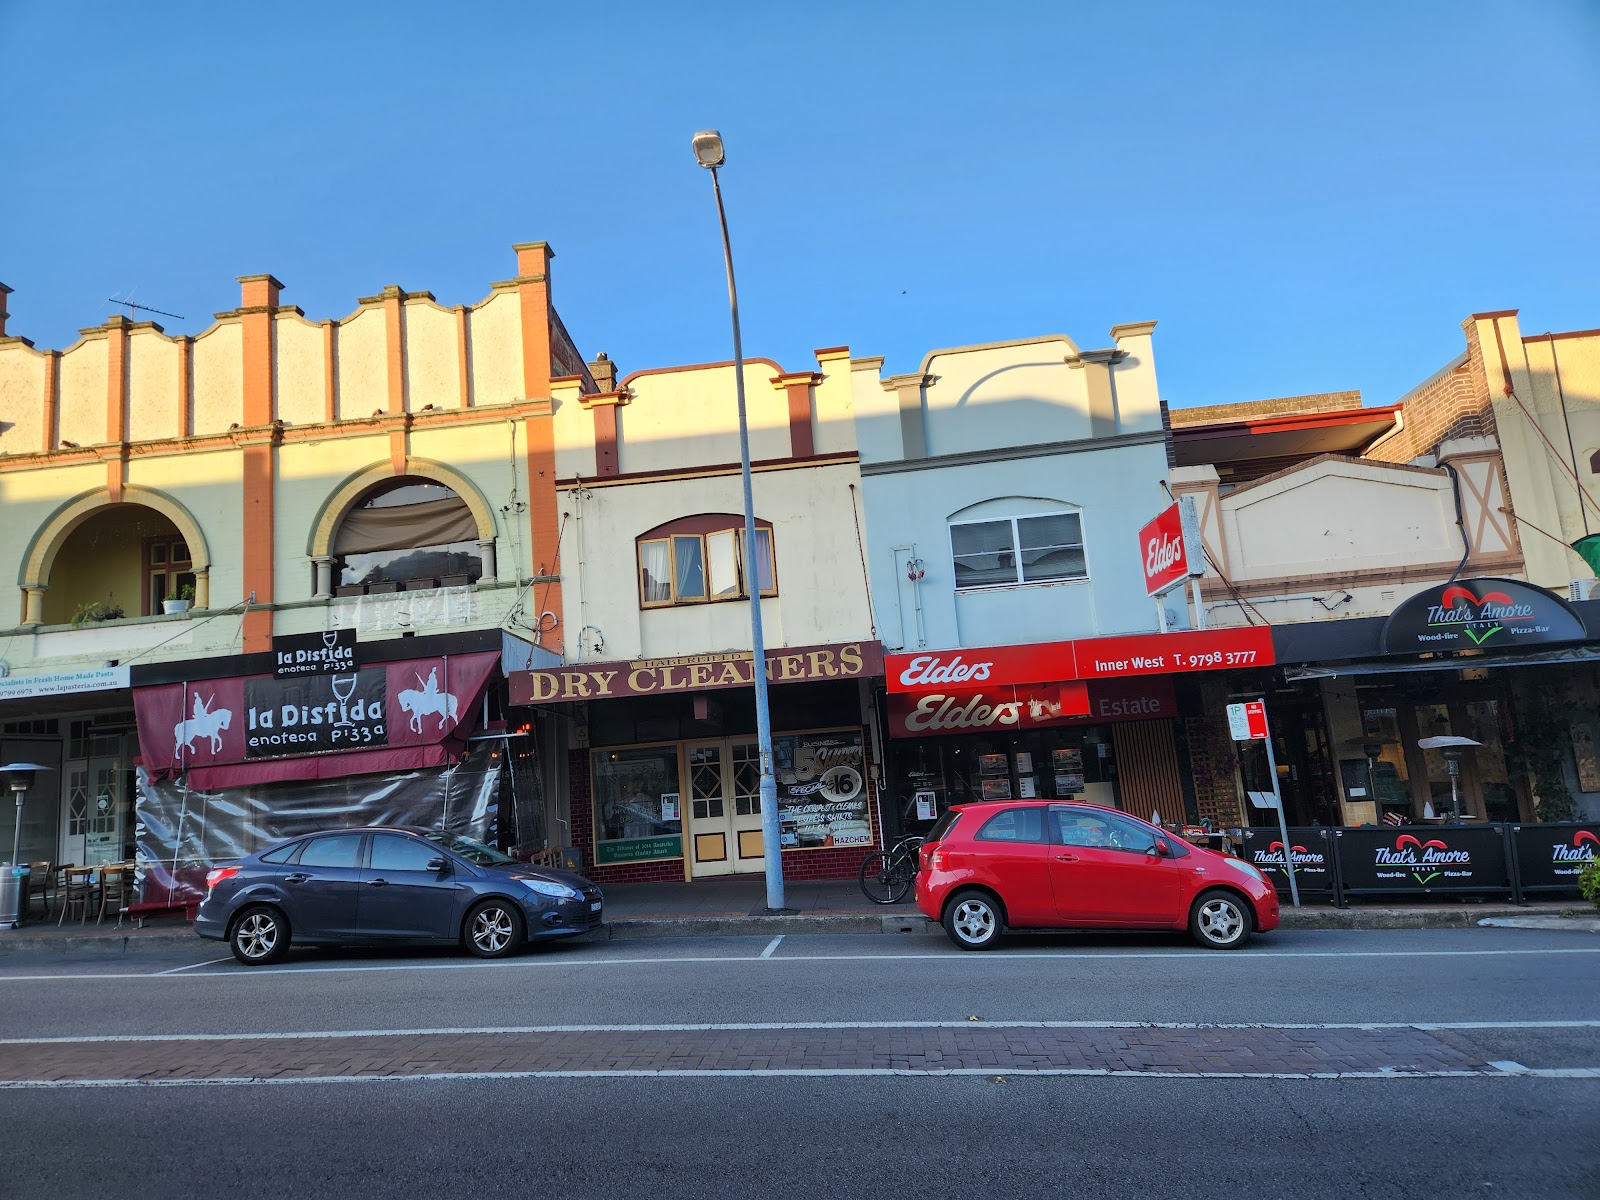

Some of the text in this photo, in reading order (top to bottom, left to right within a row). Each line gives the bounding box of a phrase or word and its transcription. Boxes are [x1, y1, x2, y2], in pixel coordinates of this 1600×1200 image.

[1147, 533, 1182, 577] Elders
[1427, 602, 1533, 623] That's Amore
[1466, 621, 1499, 630] ITALY
[1510, 625, 1550, 635] Pizza-Bar
[1417, 632, 1459, 642] Wood-fire
[277, 646, 353, 665] la Disfida
[1095, 650, 1257, 672] Inner West T. 9798 3777
[278, 664, 317, 674] enoteca
[529, 643, 863, 701] DRY CLEANERS
[900, 656, 993, 686] Elders
[0, 679, 24, 687] cialists
[34, 675, 53, 683] Fresh
[54, 674, 75, 682] Home
[76, 671, 94, 680] Made
[96, 670, 114, 678] Pasta
[17, 687, 33, 695] 6975
[39, 680, 118, 693] www.lapasteria.com.au
[249, 698, 383, 730] la Disfida
[905, 693, 1024, 732] Elders
[1099, 696, 1161, 717] Estate
[1231, 705, 1241, 715] 1P
[249, 731, 317, 747] enoteca
[794, 747, 816, 782] 5
[789, 782, 826, 794] SPECIAL
[834, 835, 871, 845] HAZCHEM
[1254, 850, 1324, 862] That's Amore
[1375, 846, 1471, 863] That's Amore
[1552, 843, 1594, 860] That's
